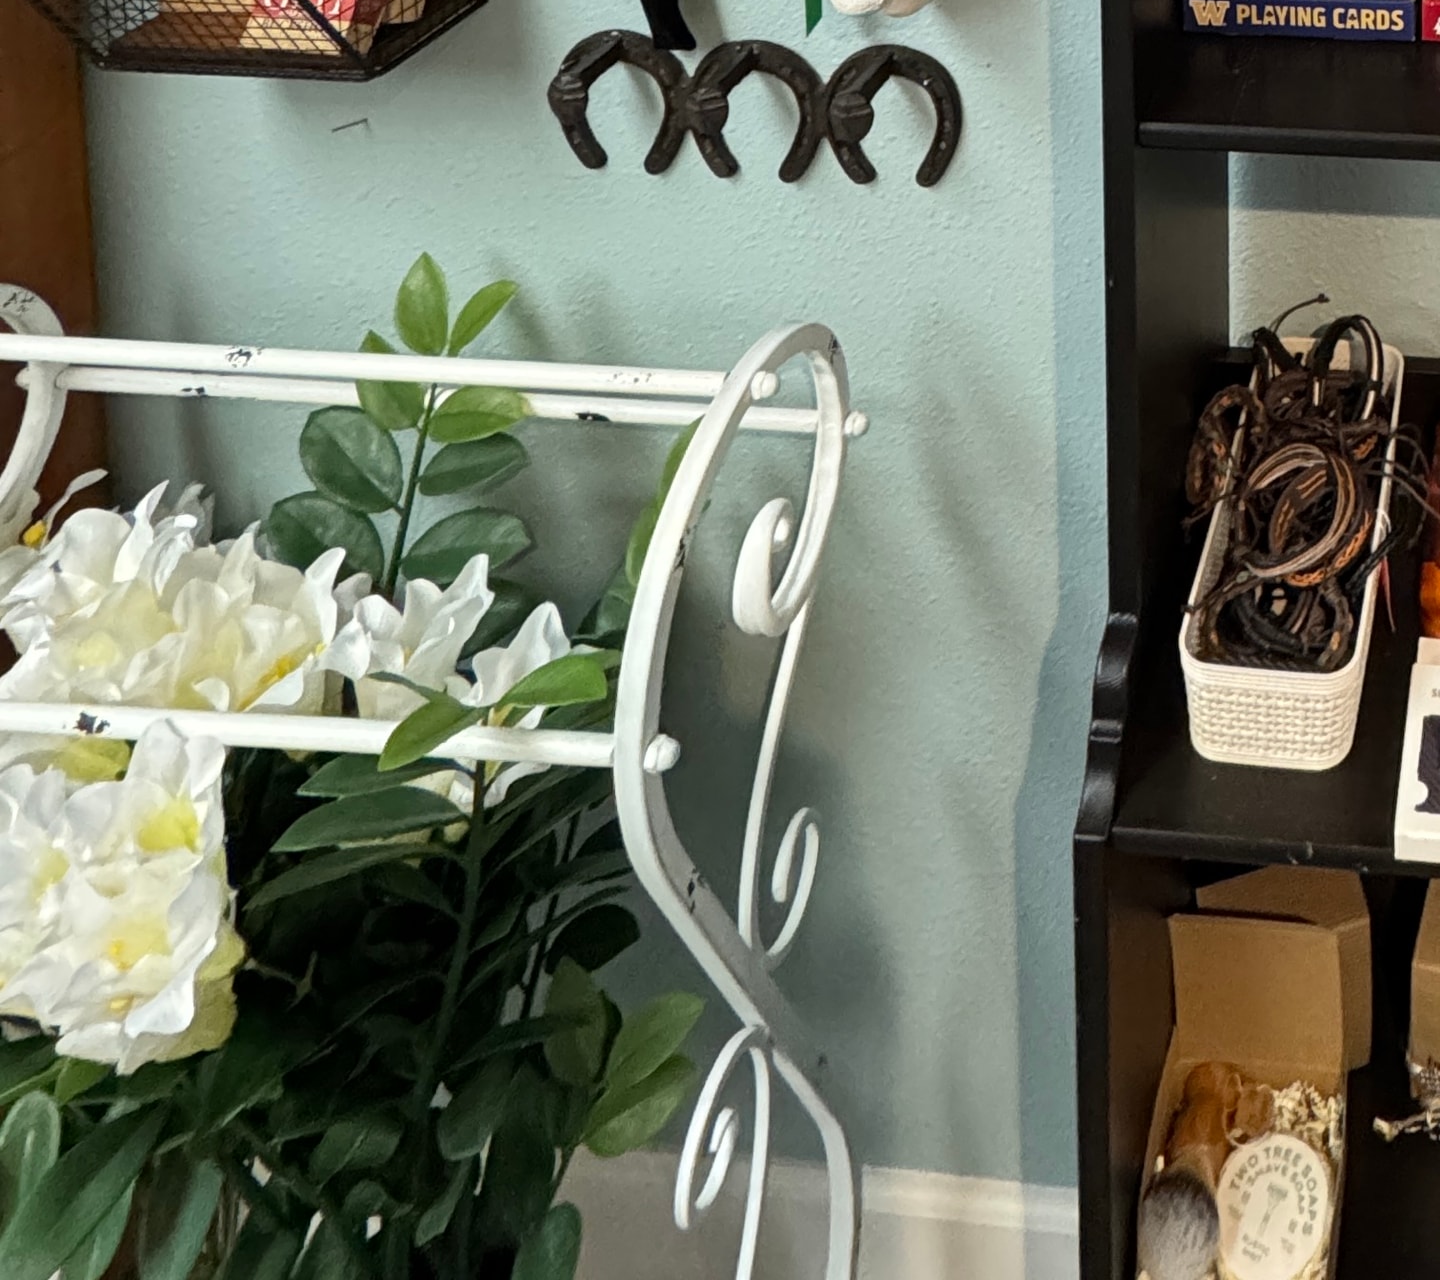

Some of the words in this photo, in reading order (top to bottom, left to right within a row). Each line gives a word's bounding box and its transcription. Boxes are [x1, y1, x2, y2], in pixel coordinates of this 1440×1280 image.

[1235, 4, 1327, 29] PLAYING
[1332, 7, 1405, 32] CARDS
[1228, 1153, 1259, 1191] TWO
